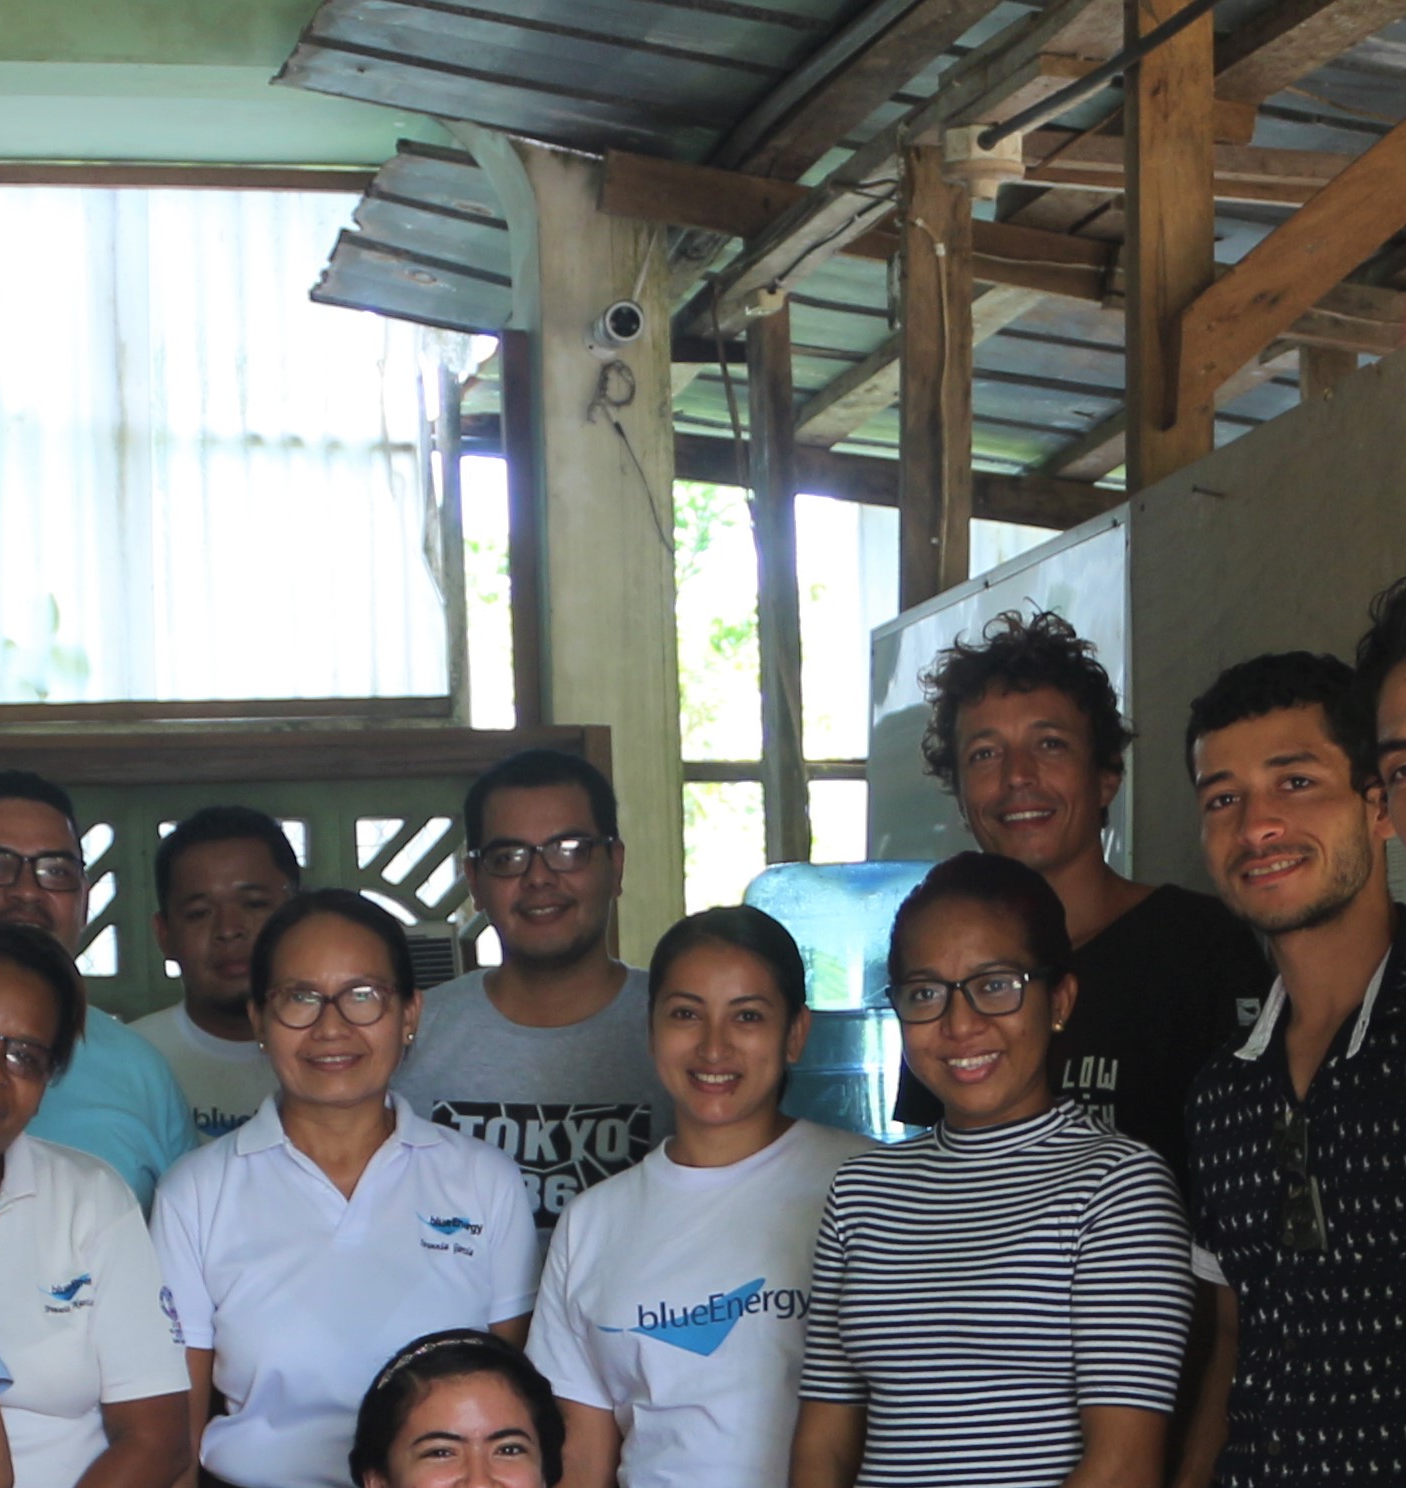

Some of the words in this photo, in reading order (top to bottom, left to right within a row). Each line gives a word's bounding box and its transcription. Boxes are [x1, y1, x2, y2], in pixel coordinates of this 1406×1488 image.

[1062, 1055, 1118, 1090] LOW
[193, 1106, 258, 1128] blue
[451, 1114, 630, 1162] TOKYO
[637, 1288, 812, 1331] blueEnergy
